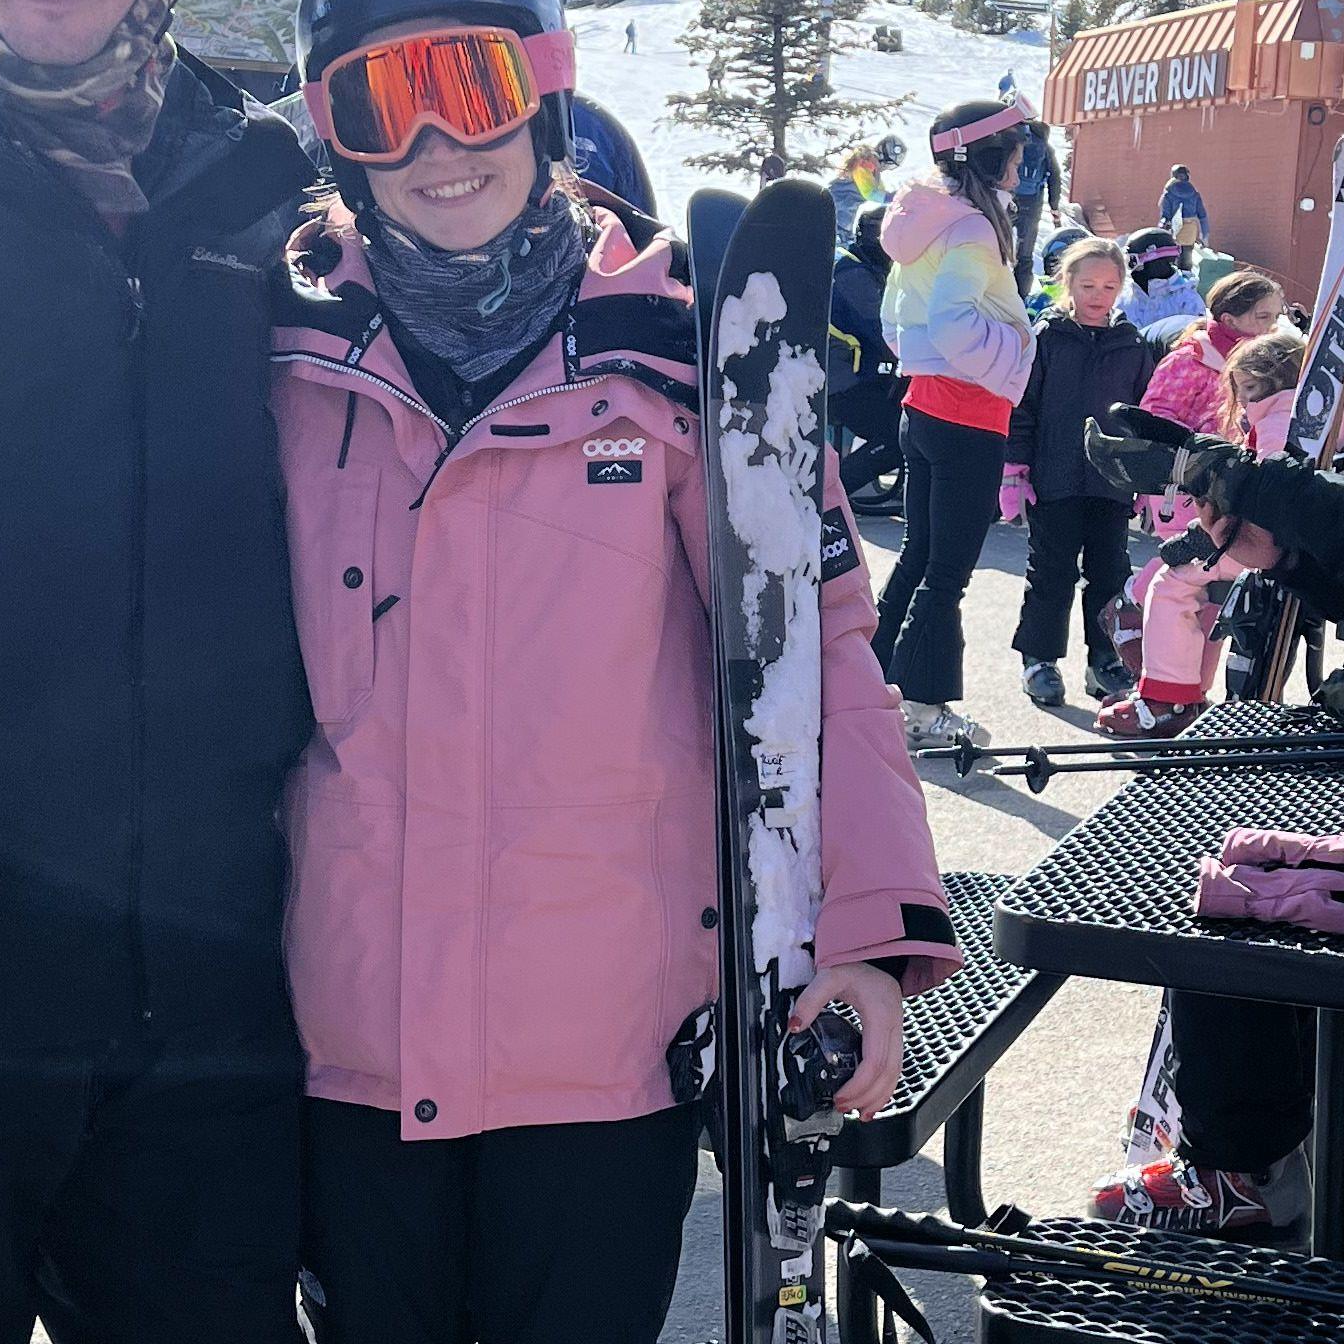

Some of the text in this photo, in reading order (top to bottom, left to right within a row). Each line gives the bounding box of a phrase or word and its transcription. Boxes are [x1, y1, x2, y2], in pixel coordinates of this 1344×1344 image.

[1084, 53, 1218, 111] BEAVER RUN
[582, 437, 647, 457] dope
